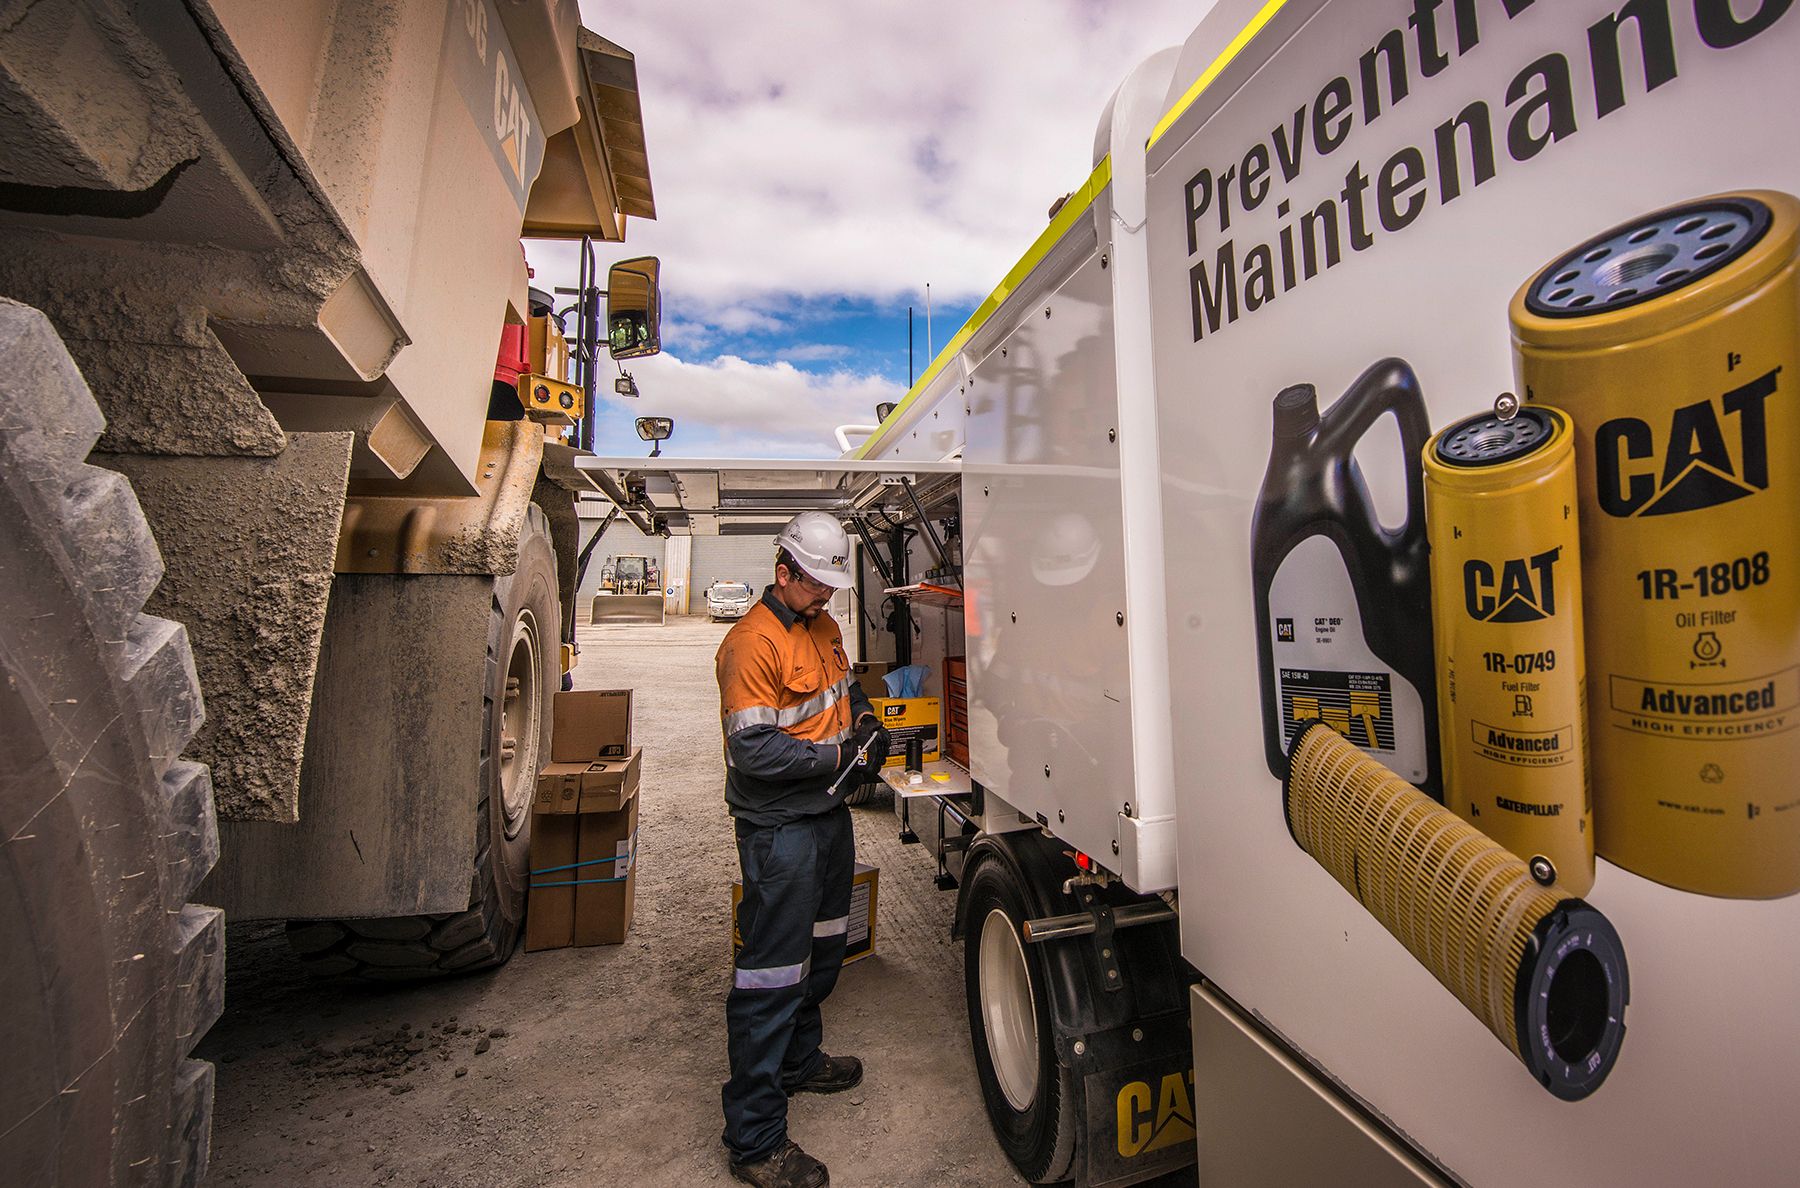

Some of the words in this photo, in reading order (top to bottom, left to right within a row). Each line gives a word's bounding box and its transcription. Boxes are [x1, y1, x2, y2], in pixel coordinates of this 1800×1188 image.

[494, 50, 530, 190] CAT
[1595, 366, 1778, 518] CAT
[831, 555, 846, 566] CAT
[1463, 547, 1559, 623] CAT
[1637, 551, 1770, 600] 1R-1808
[1675, 612, 1696, 628] Oil
[1701, 609, 1737, 626] Filter
[1278, 623, 1292, 637] CAT
[1483, 650, 1556, 674] 1R-0749
[1502, 681, 1518, 692] Fuel
[1520, 681, 1541, 692] Filter
[1641, 681, 1775, 716] Advanced
[887, 706, 900, 716] CAT
[1632, 718, 1674, 733] HIGH
[1683, 716, 1787, 736] EFFICIENCY
[1487, 729, 1559, 751] Advanced
[1483, 748, 1506, 760] HIGH
[1510, 755, 1564, 765] EFFICIENCY
[1117, 1069, 1195, 1157] CA
